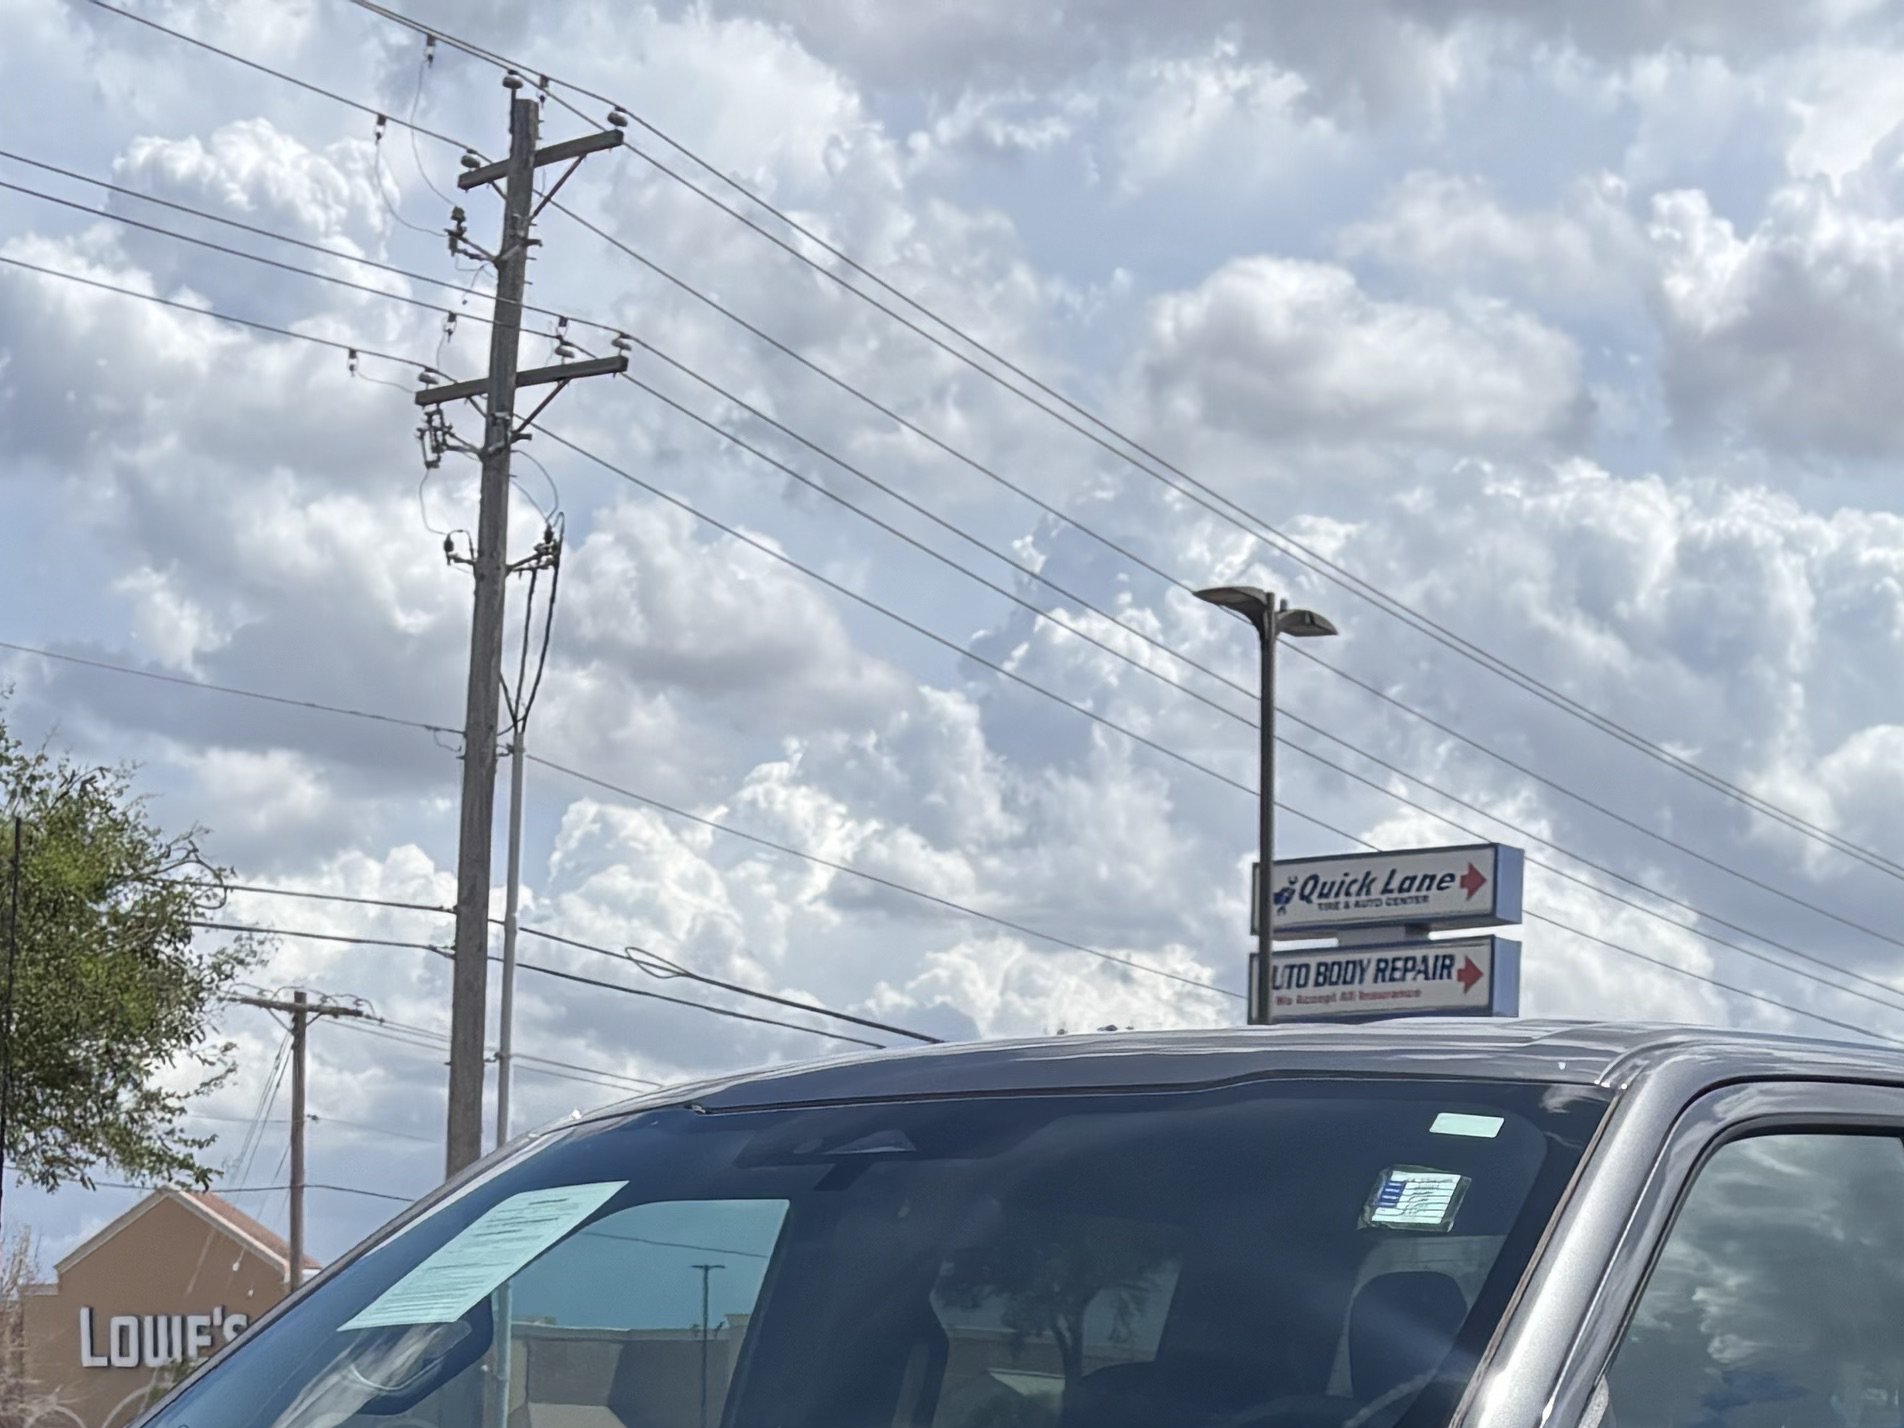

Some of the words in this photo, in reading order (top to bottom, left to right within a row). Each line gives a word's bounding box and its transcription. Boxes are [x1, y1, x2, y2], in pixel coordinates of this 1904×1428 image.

[1299, 872, 1377, 904] Quick
[1381, 869, 1456, 896] Lane
[1271, 964, 1308, 991] UTO
[1313, 958, 1370, 987] BODY
[1373, 953, 1456, 983] REPAIR
